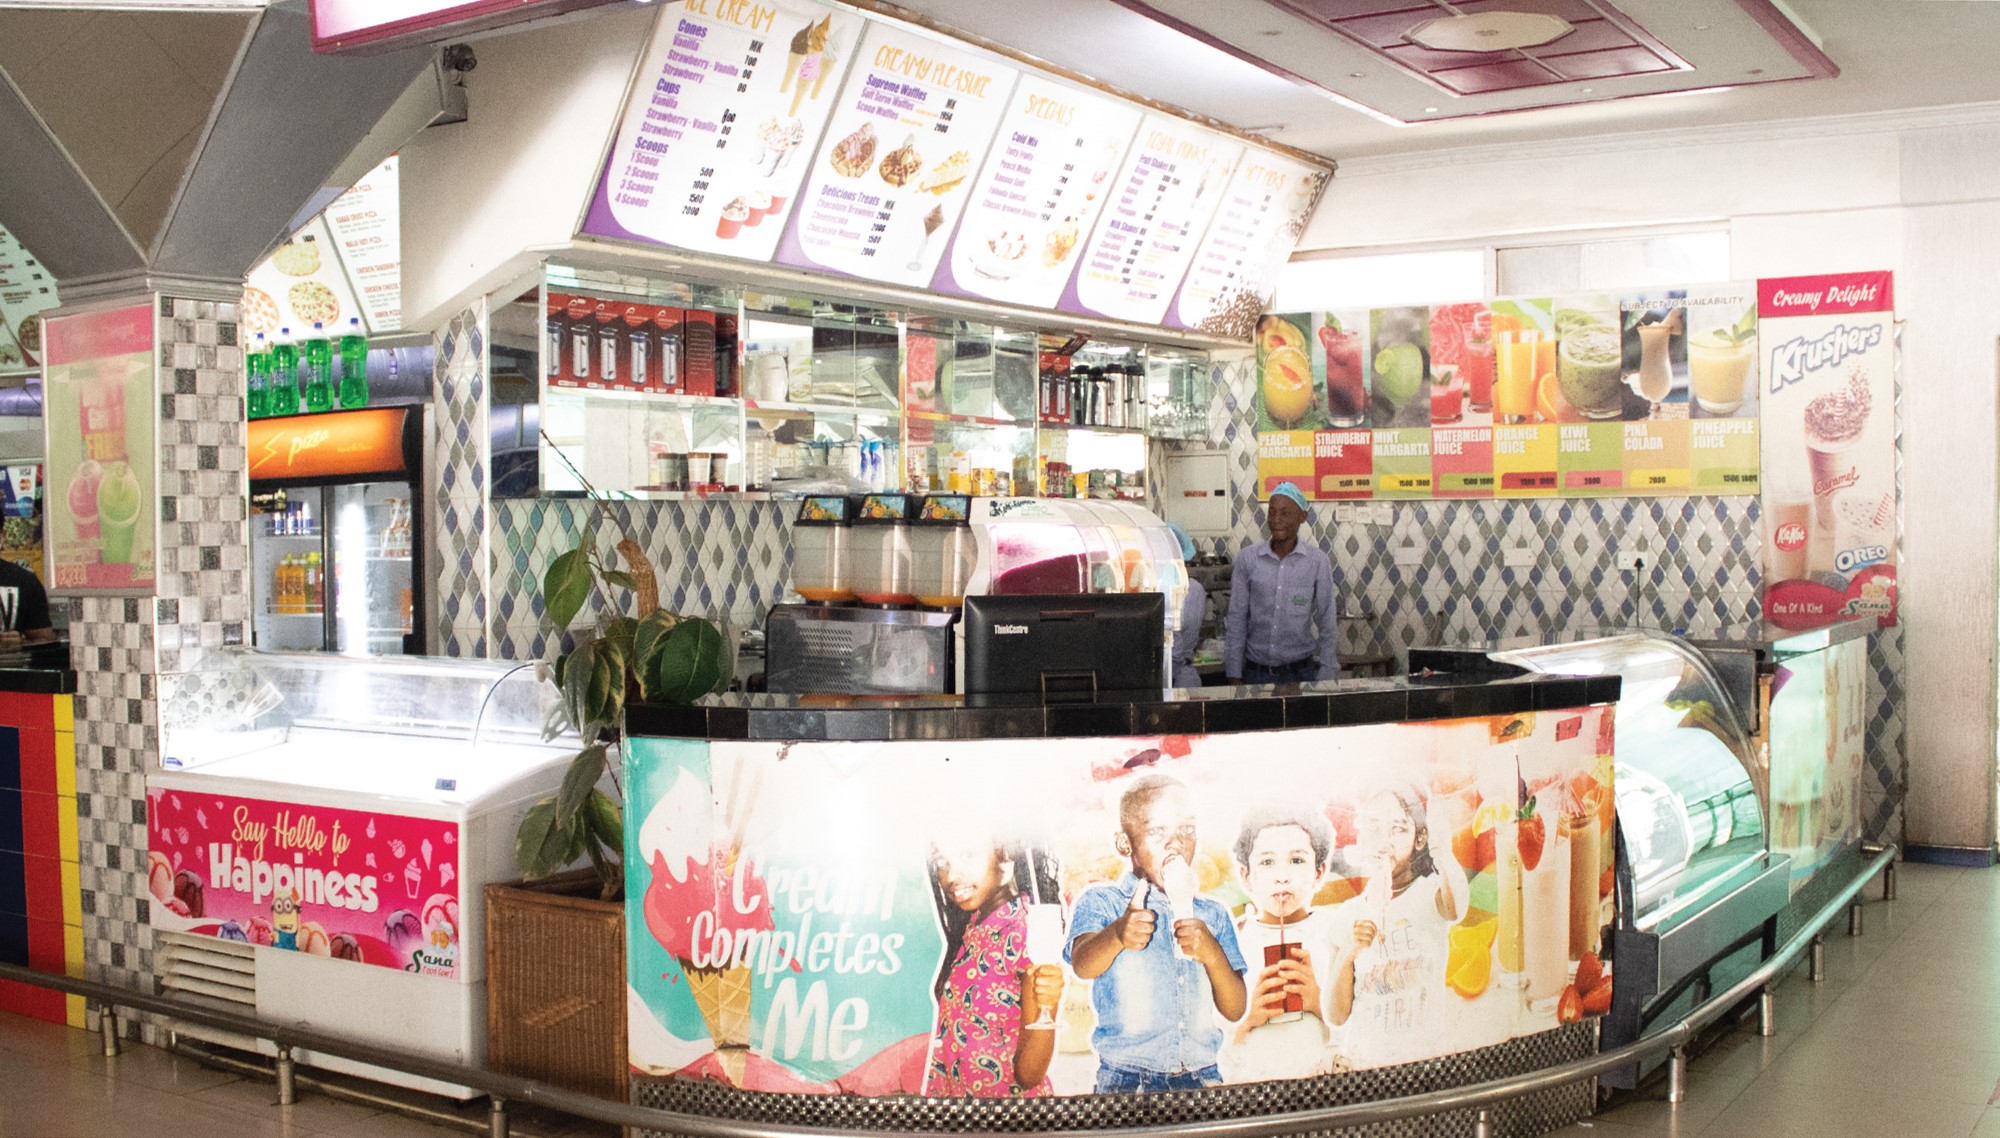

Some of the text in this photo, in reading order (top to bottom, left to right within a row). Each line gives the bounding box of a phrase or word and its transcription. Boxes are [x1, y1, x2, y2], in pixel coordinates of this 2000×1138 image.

[716, 0, 776, 33] CREAM
[677, 18, 708, 38] Cones
[672, 34, 700, 52] Vanilla
[667, 49, 739, 77] Strawberry Vanilla
[873, 44, 992, 98] CREAMY PLEASURE
[662, 63, 705, 84] Strawberry
[655, 77, 681, 95] Cups
[865, 73, 928, 102] Supreme Waffles
[651, 93, 678, 109] Vanilla
[874, 91, 892, 105] Serve
[891, 95, 915, 111] Waffles
[1024, 92, 1077, 127] SPECIALS
[646, 108, 718, 133] Strawberry Vanilla
[875, 105, 899, 120] Waffles
[641, 121, 683, 140] Strawberry
[635, 136, 669, 154] Scoops
[635, 153, 659, 167] Scoop
[632, 167, 659, 181] Scoops
[626, 180, 654, 194] Scoops
[821, 184, 881, 207] Delicious Treats
[621, 194, 649, 208] Scoops
[816, 198, 848, 213] Chocolate
[1622, 300, 1663, 311] SUBJECT
[1680, 296, 1744, 308] AVAILABILITY
[1773, 283, 1878, 310] Creamy Delight
[1770, 323, 1883, 394] Krushers
[1373, 431, 1399, 443] MINT
[1433, 429, 1492, 442] WATERMELON
[1496, 427, 1538, 440] ORANGE
[1560, 425, 1588, 438] KIWI
[1624, 423, 1648, 437] PINA
[1693, 421, 1754, 435] PINEAPPLE
[1259, 433, 1290, 446] PEACH
[1315, 432, 1371, 445] STRAWBERRY
[1496, 440, 1525, 454] JUICE
[1560, 439, 1591, 452] JUICE
[1624, 437, 1664, 451] COLADA
[1693, 435, 1726, 449] JUICE
[1315, 445, 1343, 458] JUICE
[1434, 442, 1463, 455] JUICE
[1813, 466, 1860, 496] Caramel
[1836, 545, 1888, 573] OREO
[1773, 602, 1787, 614] One
[1789, 602, 1798, 614] Of
[1807, 603, 1823, 614] Kind
[231, 805, 351, 861] Say Hello to
[208, 842, 379, 913] Happiness
[733, 846, 899, 921] Cream
[692, 911, 905, 988] Completes
[405, 949, 454, 974] Sana
[763, 977, 869, 1062] Me
